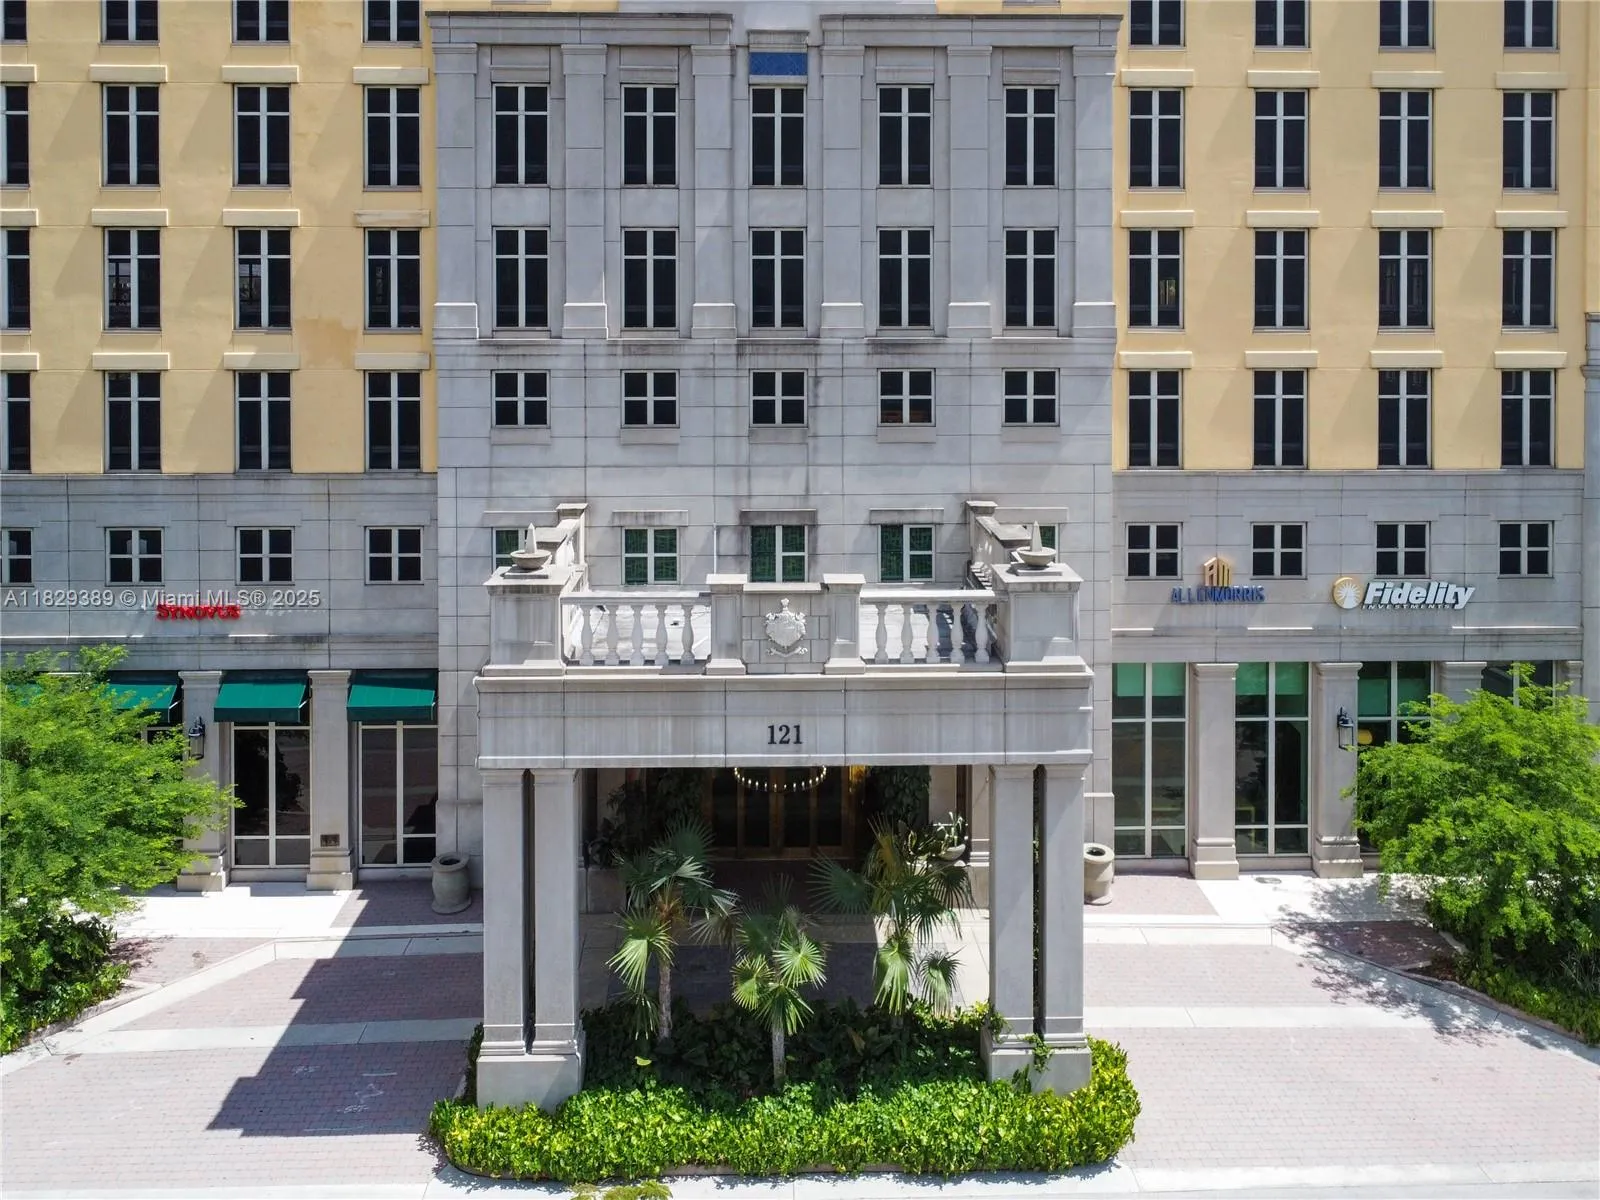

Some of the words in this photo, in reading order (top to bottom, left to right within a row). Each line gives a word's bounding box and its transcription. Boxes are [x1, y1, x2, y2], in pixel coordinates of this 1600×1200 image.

[1364, 581, 1475, 609] Fidelity
[156, 603, 241, 620] SYNOVUS
[767, 724, 803, 745] 121
